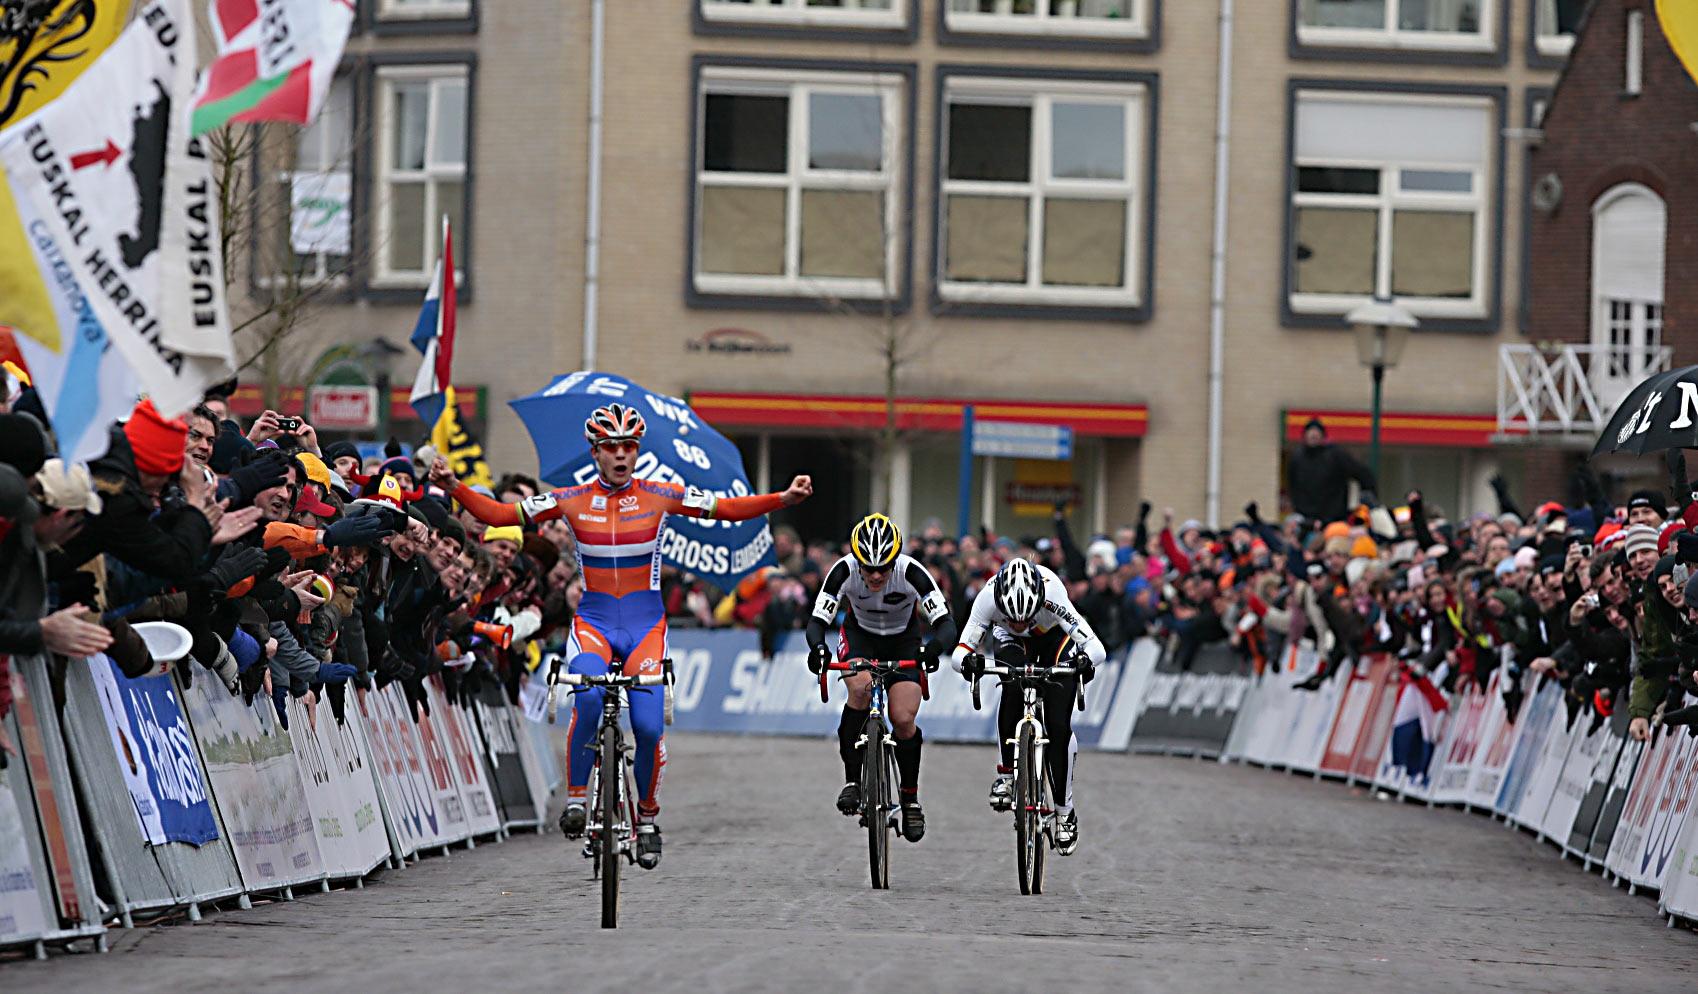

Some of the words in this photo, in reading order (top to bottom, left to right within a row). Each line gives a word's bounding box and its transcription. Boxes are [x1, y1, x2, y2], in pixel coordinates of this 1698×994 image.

[24, 123, 90, 246] EUSKAL
[187, 177, 216, 327] EUSKAL
[661, 527, 730, 576] CROSS
[822, 598, 837, 614] 14
[923, 598, 938, 614] 14
[1076, 628, 1088, 639] 1
